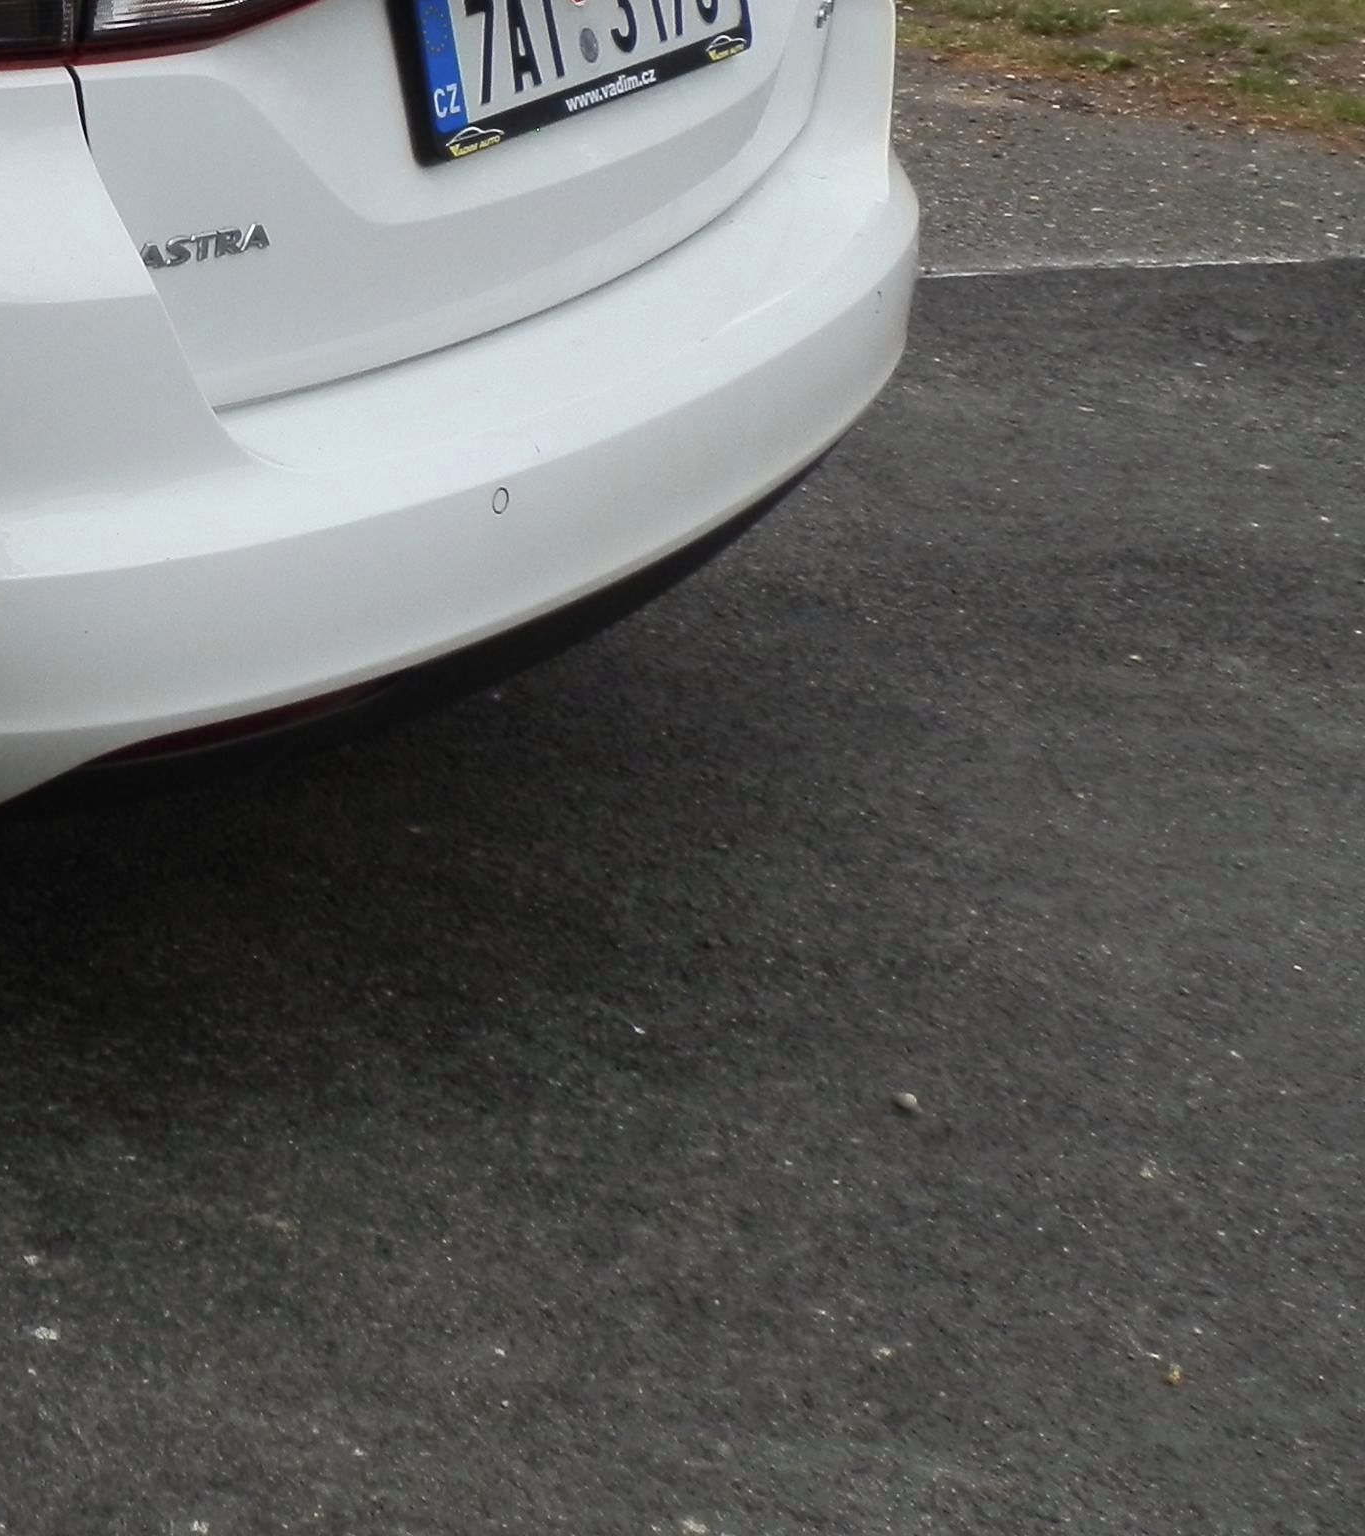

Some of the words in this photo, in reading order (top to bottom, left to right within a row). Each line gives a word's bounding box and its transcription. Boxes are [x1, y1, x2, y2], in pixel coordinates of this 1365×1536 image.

[433, 82, 462, 119] CZ
[564, 67, 658, 112] www.vadim.cz
[140, 222, 271, 269] ASTRA
